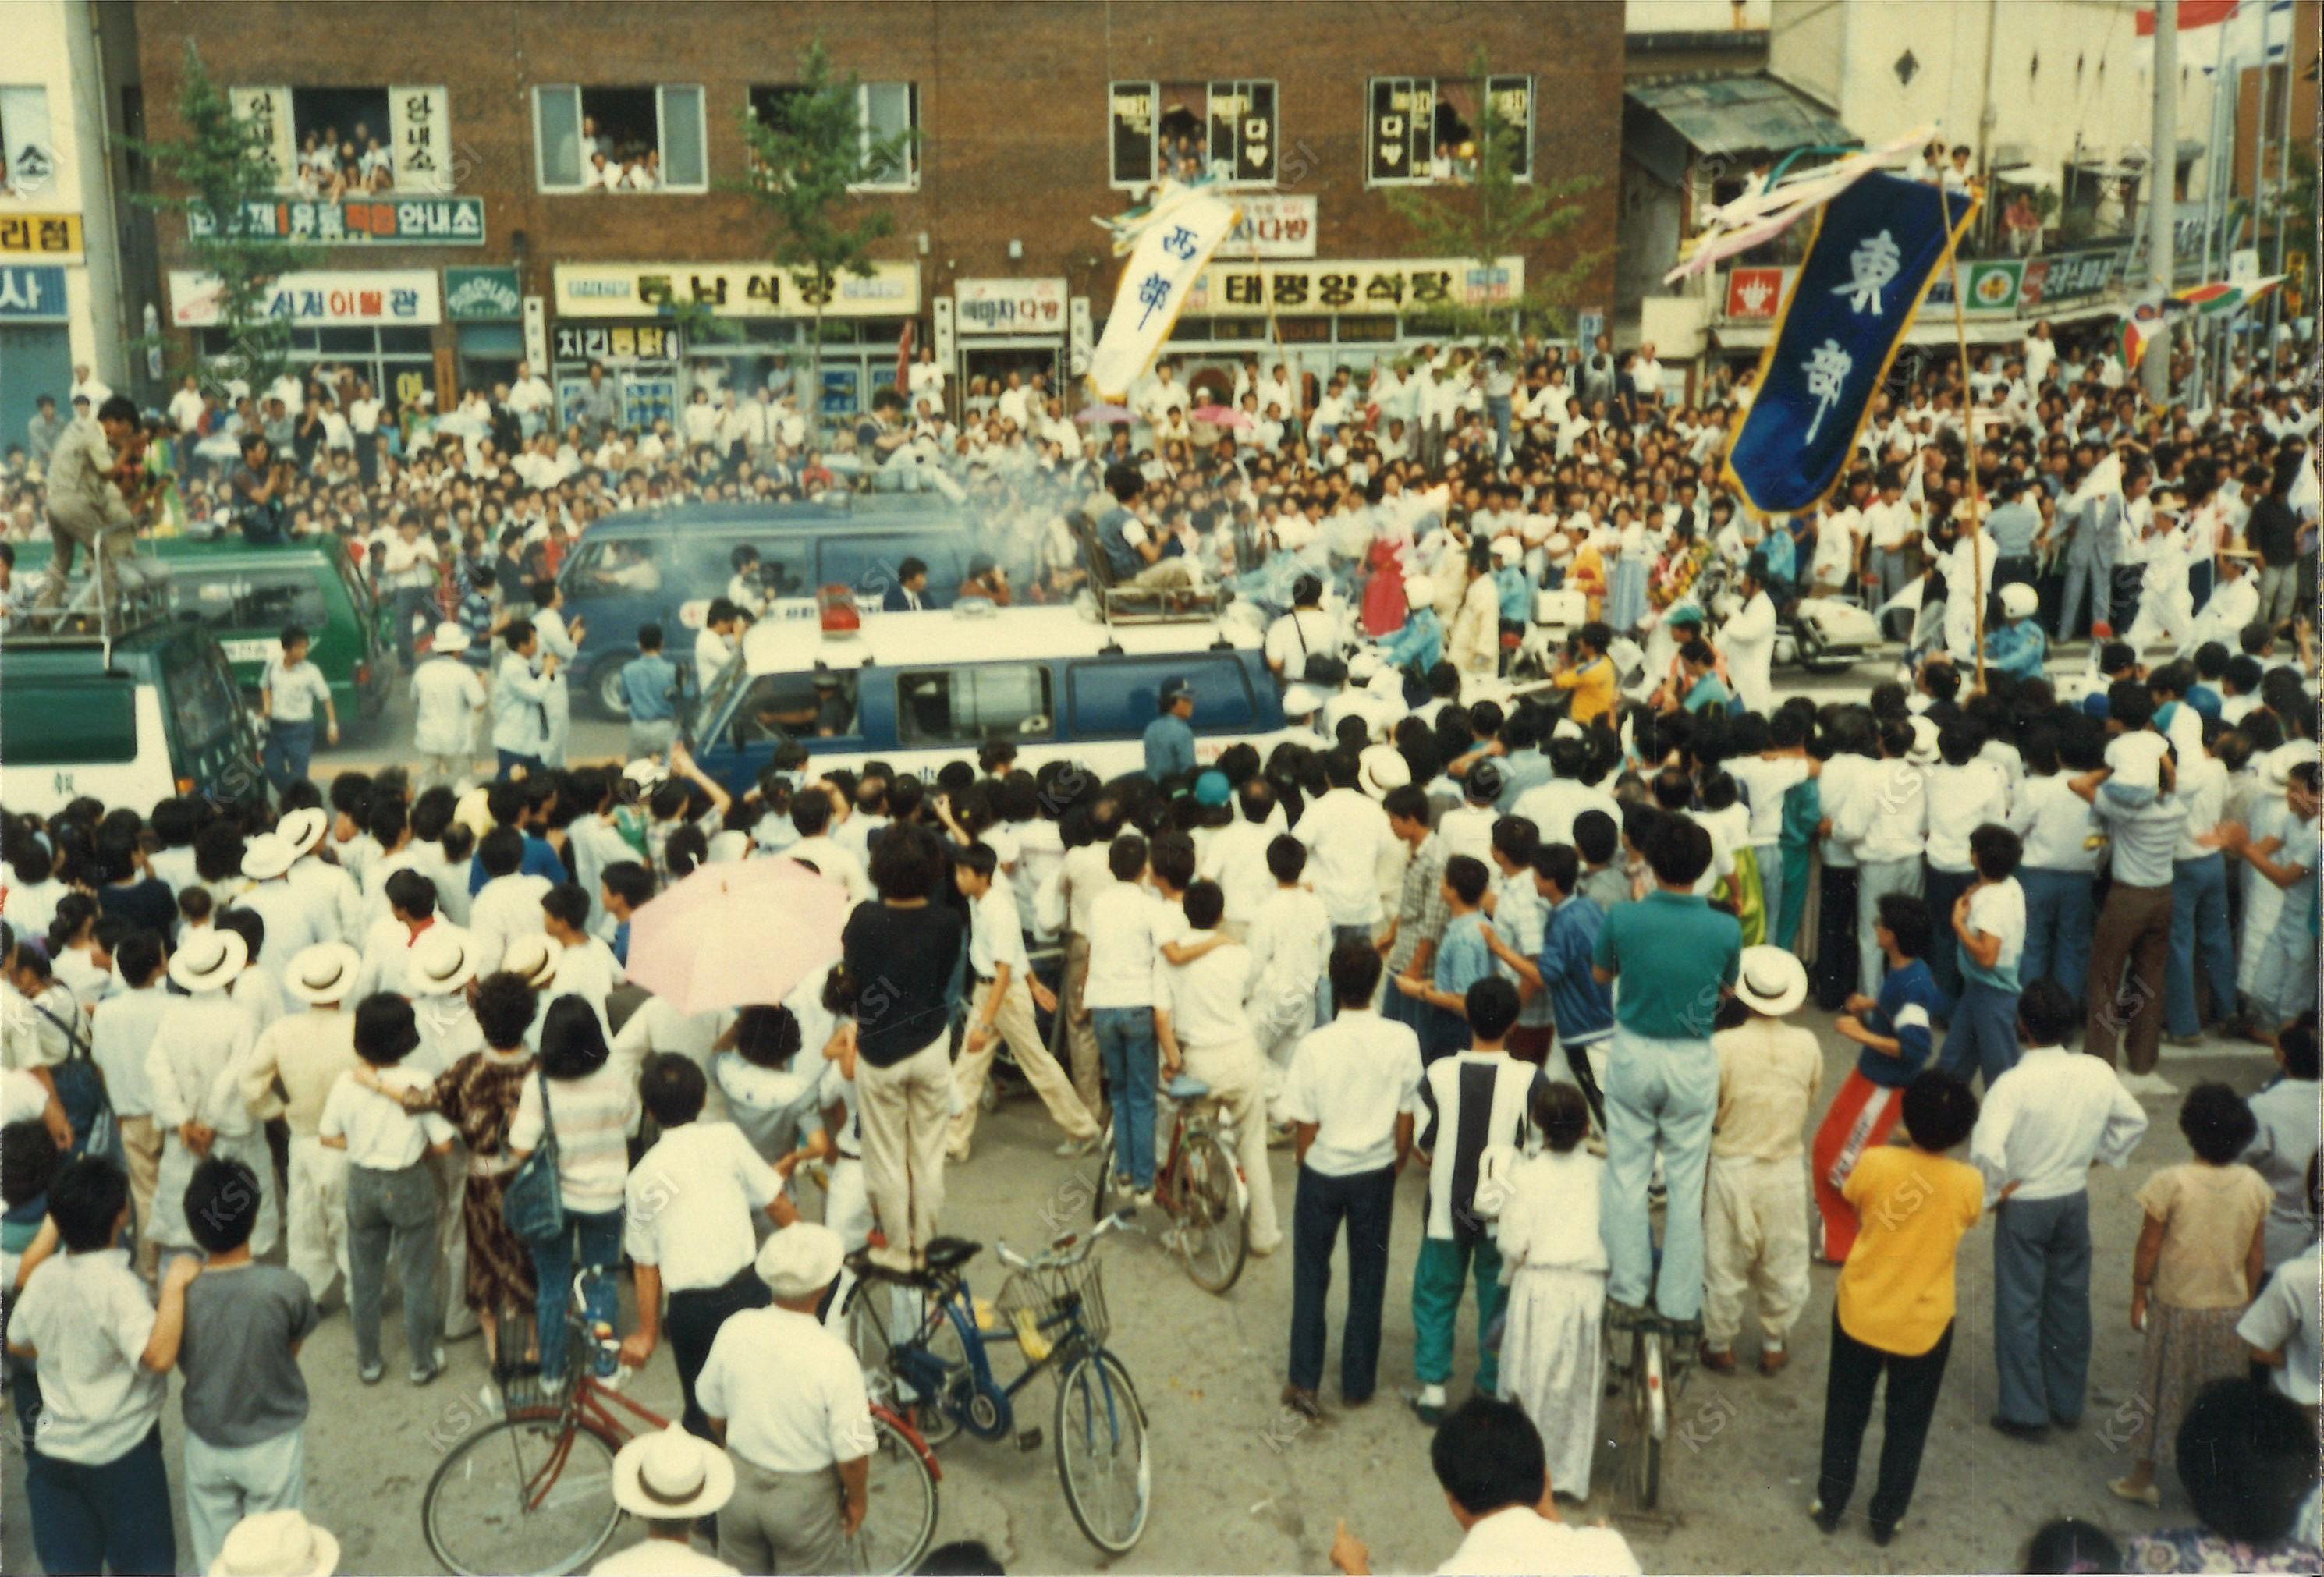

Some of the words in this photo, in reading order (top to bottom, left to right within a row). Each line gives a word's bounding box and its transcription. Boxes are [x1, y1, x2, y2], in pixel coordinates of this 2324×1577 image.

[405, 85, 436, 172] 안내소
[1138, 225, 1199, 331] 西部
[1800, 229, 1902, 445] 東部
